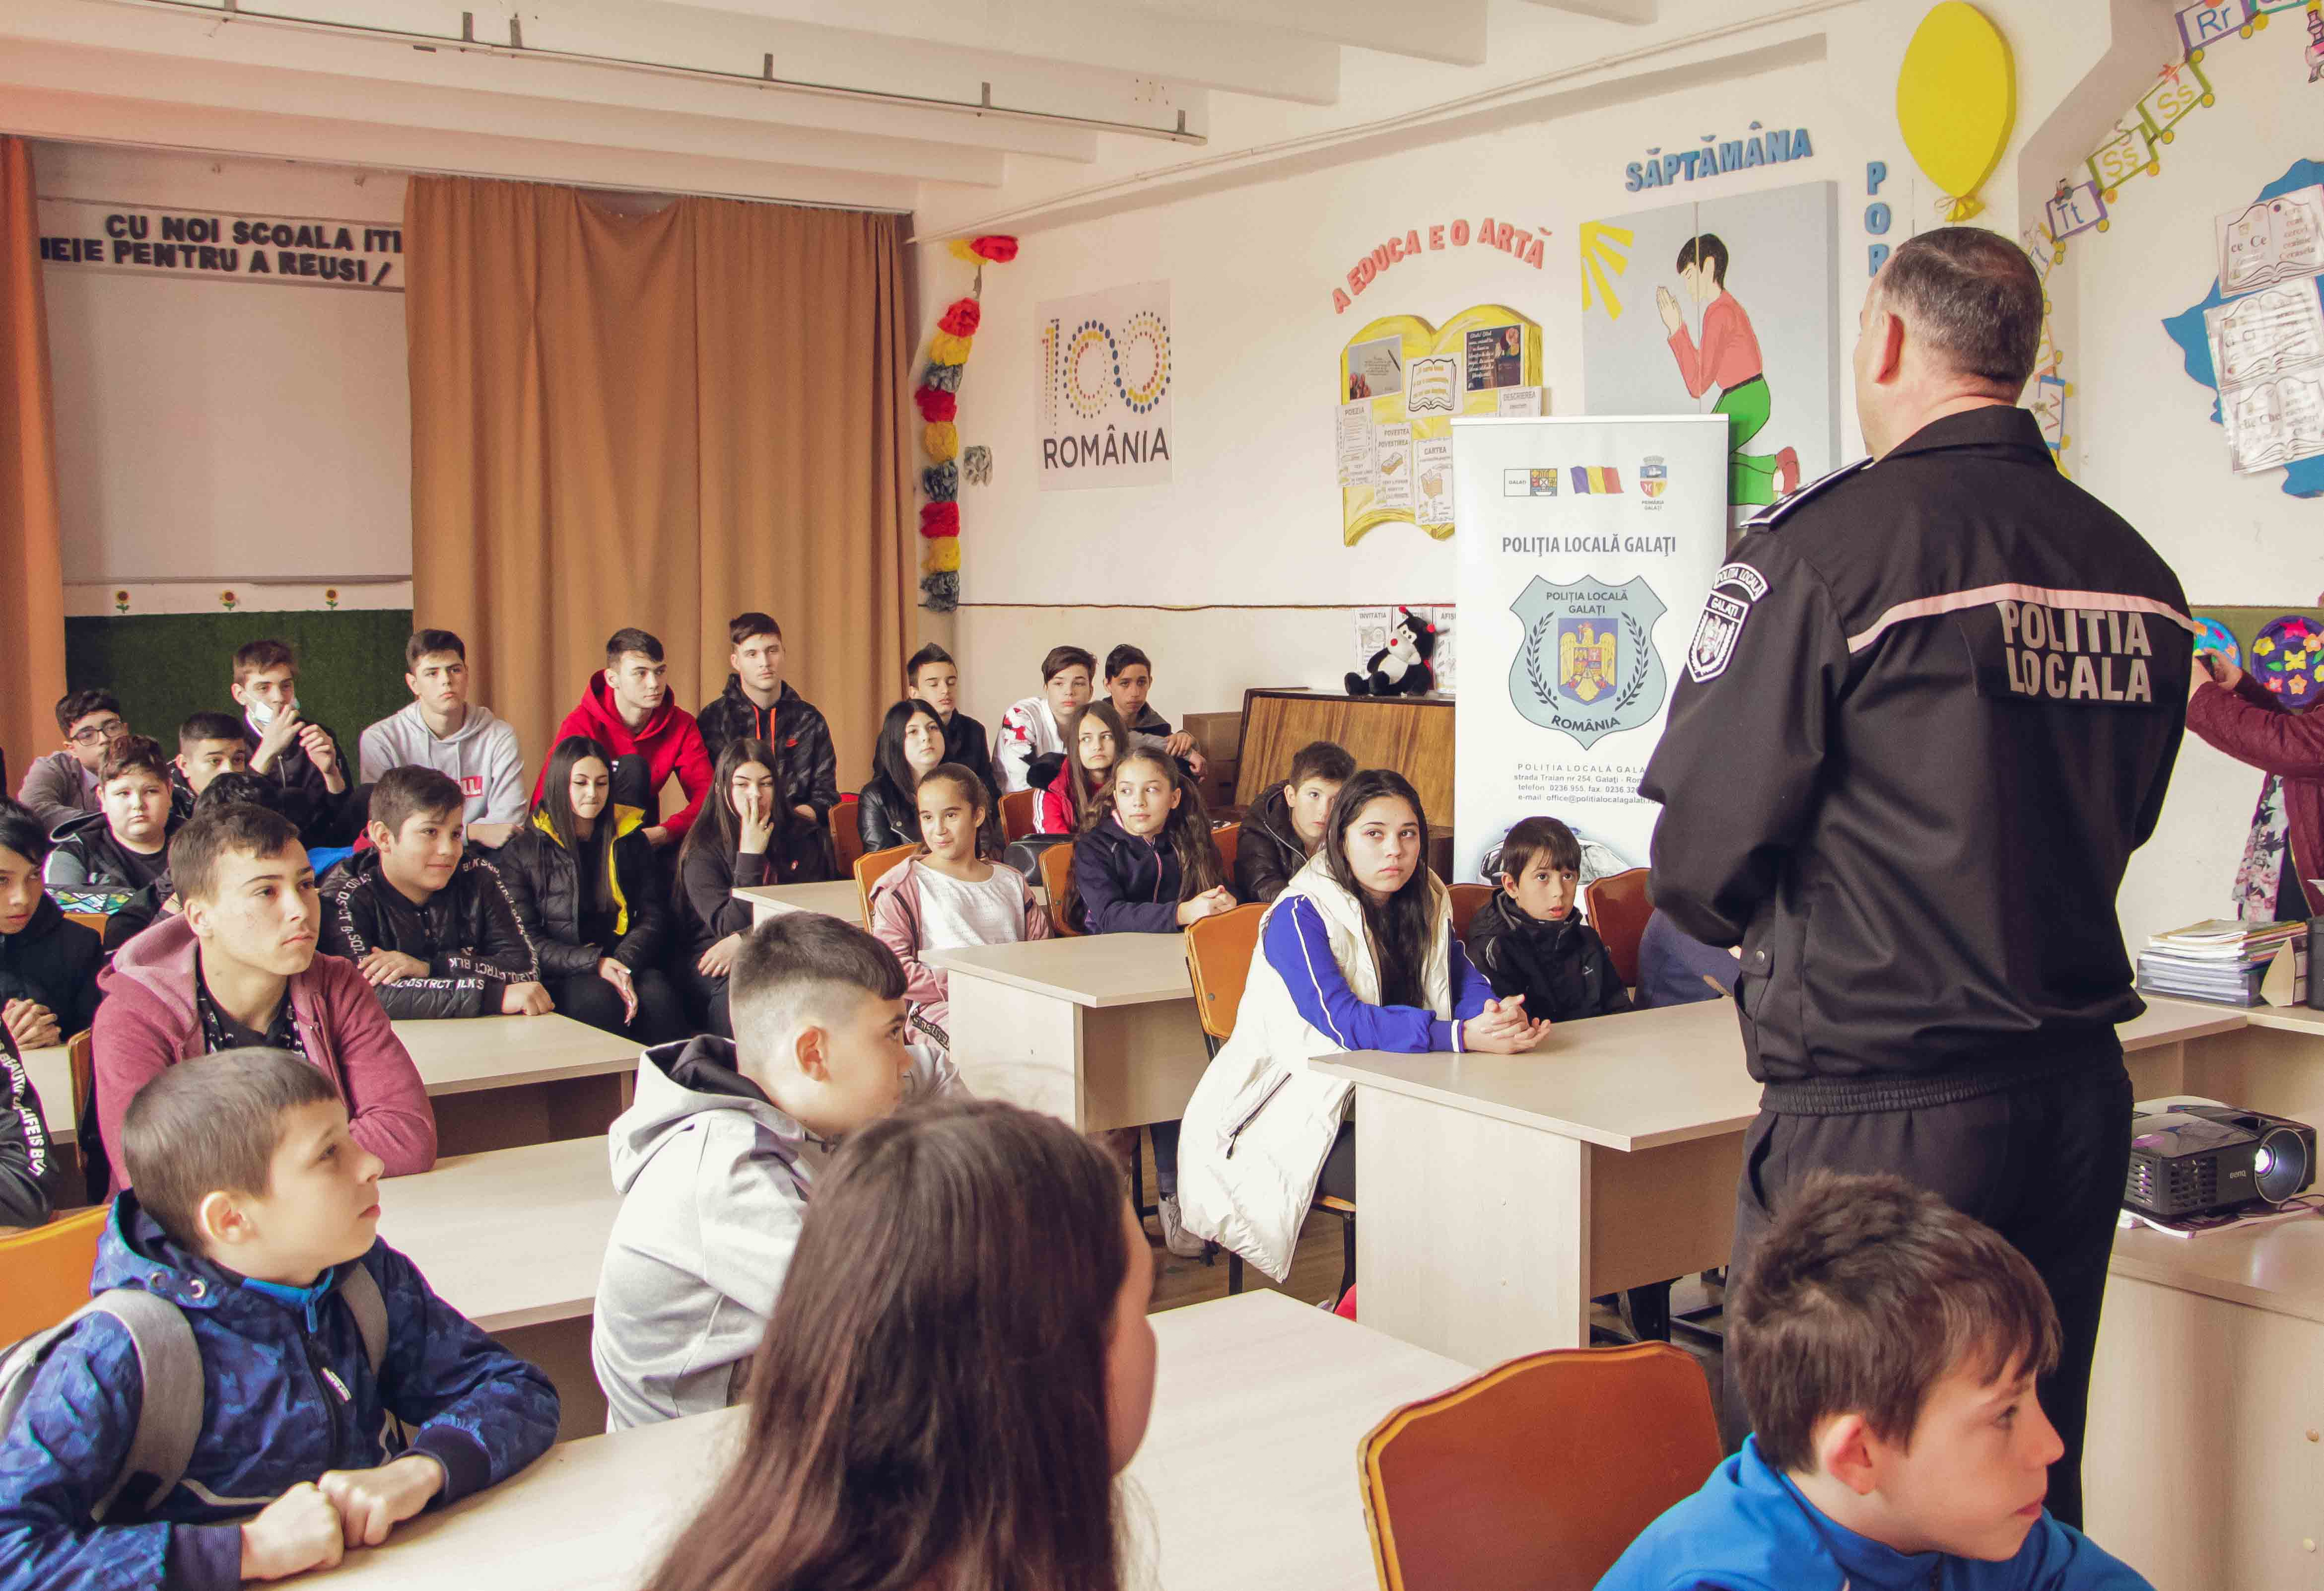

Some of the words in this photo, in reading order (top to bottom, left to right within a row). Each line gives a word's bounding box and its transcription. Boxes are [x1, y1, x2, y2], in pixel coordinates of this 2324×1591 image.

[2196, 7, 2231, 39] Rr
[1625, 121, 1814, 192] SĂPTĂMÂNA
[105, 214, 149, 240] CU
[162, 216, 220, 244] NOI
[232, 221, 354, 252] SCOALA
[114, 240, 238, 272] PENTRU
[250, 251, 271, 274] A
[278, 251, 368, 283] REUSI
[1332, 287, 1352, 315] A
[1347, 230, 1422, 295] EDUCA
[1429, 225, 1445, 250] E
[1450, 219, 1470, 246] O
[1043, 425, 1169, 469] ROMÂNIA
[1565, 533, 1620, 552] LOCALĂ
[1587, 589, 1629, 600] LOCALĂ
[1994, 600, 2152, 656] POLITIA
[2006, 647, 2151, 702] LOCALA
[1551, 714, 1621, 731] ROMÂNIA
[22, 1107, 42, 1136] LIFE
